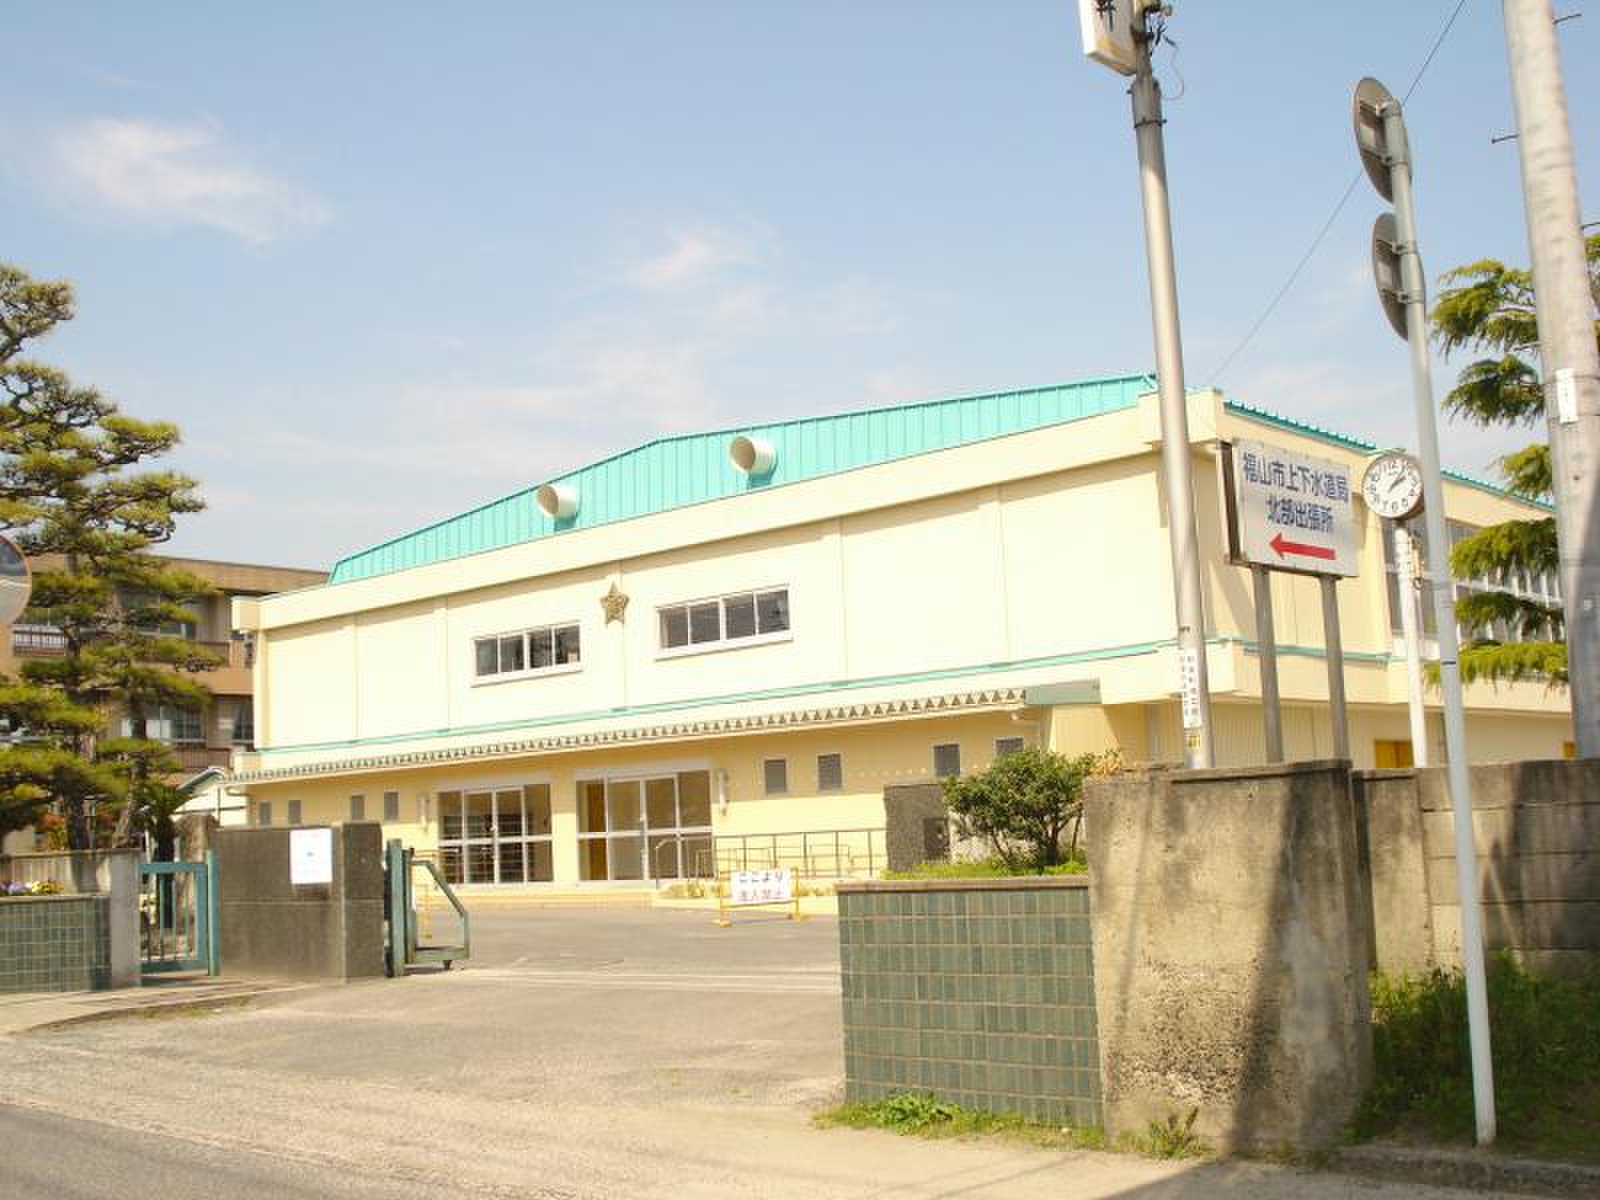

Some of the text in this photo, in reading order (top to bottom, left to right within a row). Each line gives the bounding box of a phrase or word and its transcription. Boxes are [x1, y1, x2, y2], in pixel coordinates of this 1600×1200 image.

[1242, 451, 1348, 504] 福山市上下水道局
[1265, 494, 1334, 534] 北部出張所
